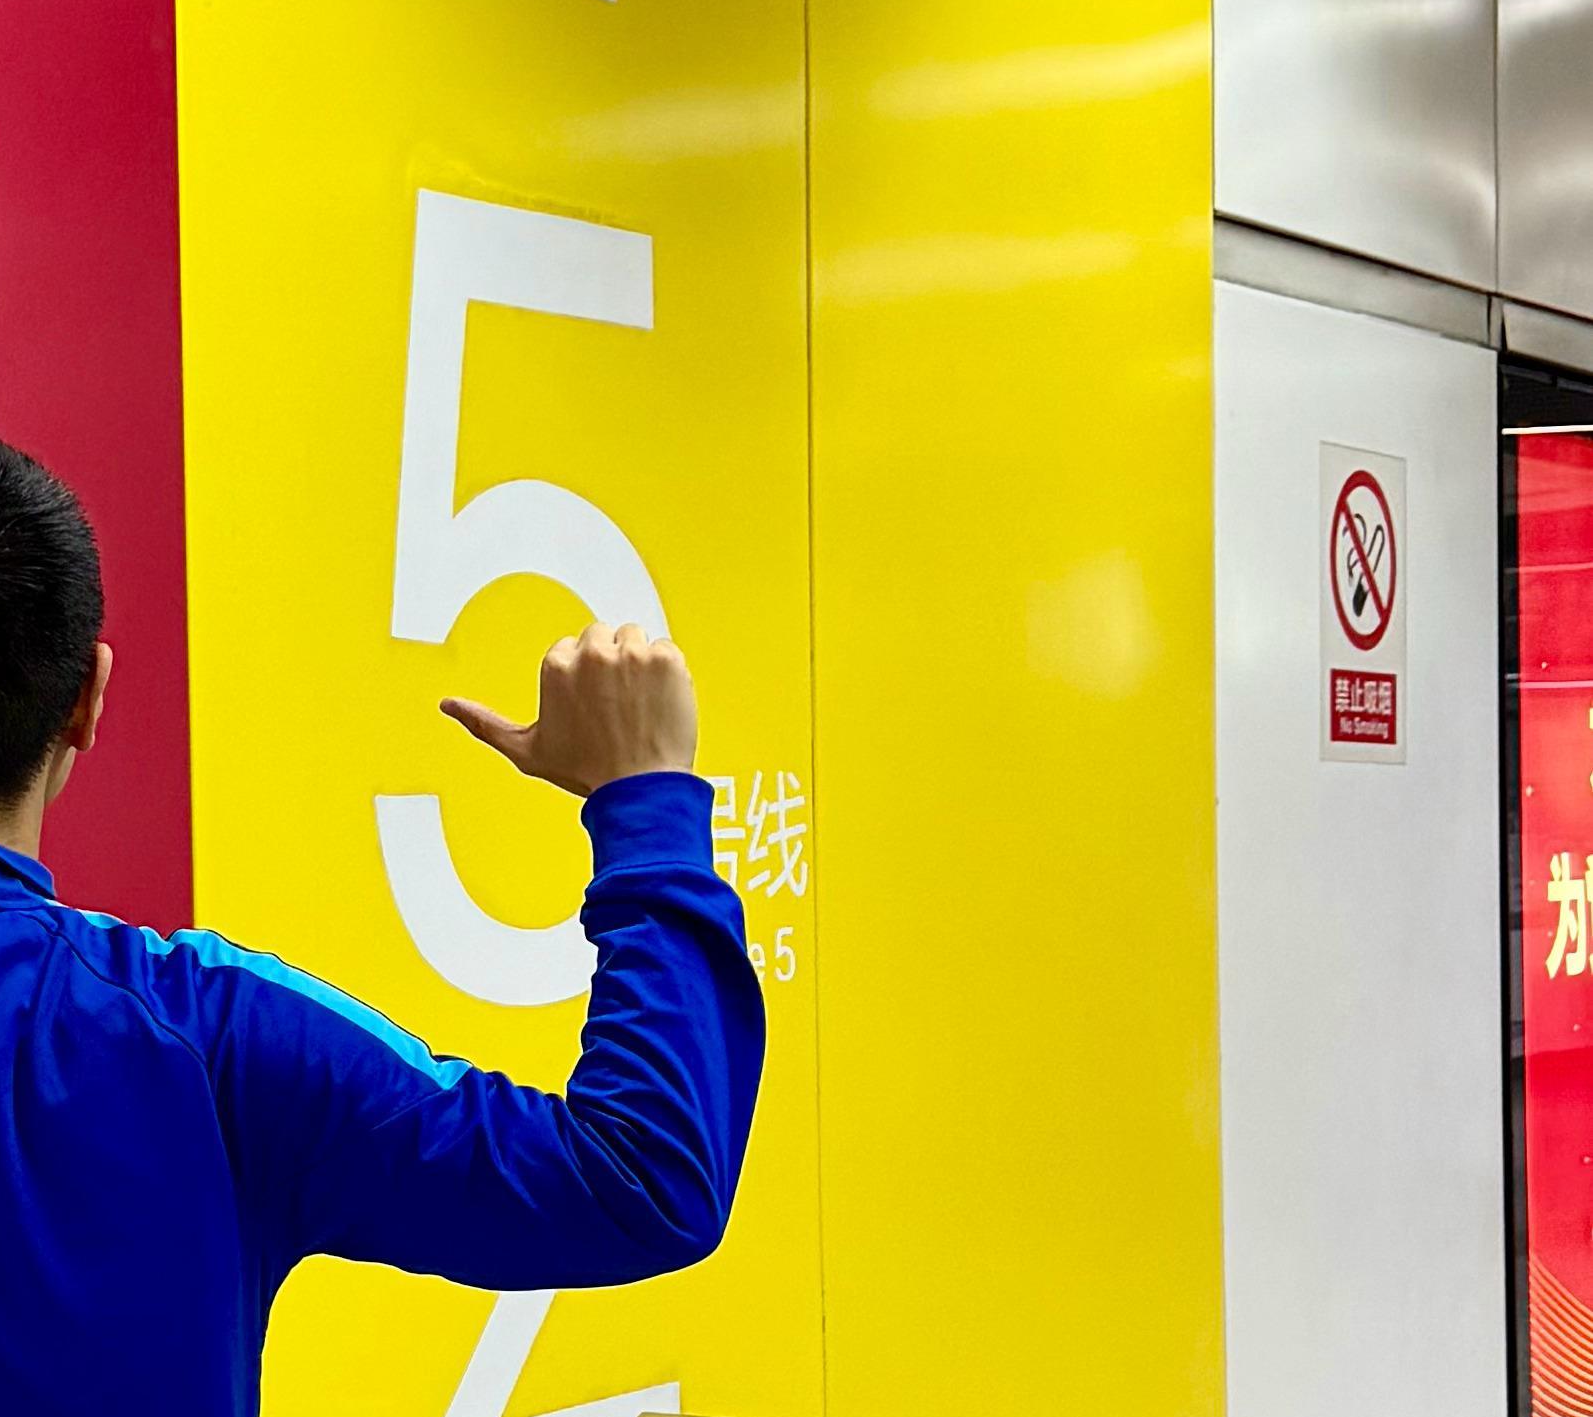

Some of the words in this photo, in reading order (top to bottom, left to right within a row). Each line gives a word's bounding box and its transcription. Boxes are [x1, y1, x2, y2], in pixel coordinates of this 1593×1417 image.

[374, 188, 674, 1008] 5
[1334, 676, 1393, 716] 禁止吸烟
[774, 926, 796, 982] 5
[1545, 851, 1593, 980] 为
